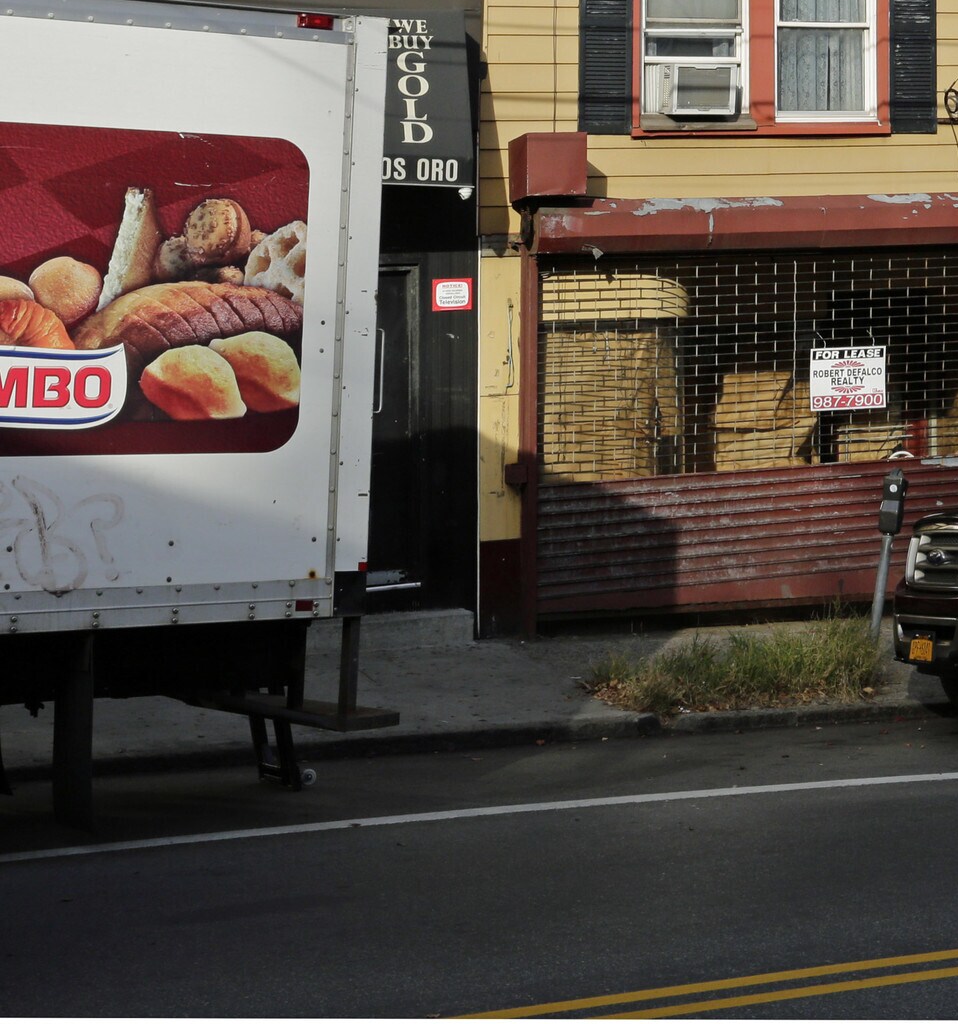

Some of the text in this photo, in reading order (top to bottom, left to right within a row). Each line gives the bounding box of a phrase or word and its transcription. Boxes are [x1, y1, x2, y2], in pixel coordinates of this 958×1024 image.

[392, 19, 428, 34] WE
[388, 35, 434, 50] BUY
[396, 51, 434, 144] GOLD
[417, 158, 459, 182] ORO
[815, 349, 881, 360] FOR LEASE
[813, 367, 883, 378] ROBERT DEFALCO
[831, 376, 865, 386] REALTY
[813, 394, 883, 409] 987-7900
